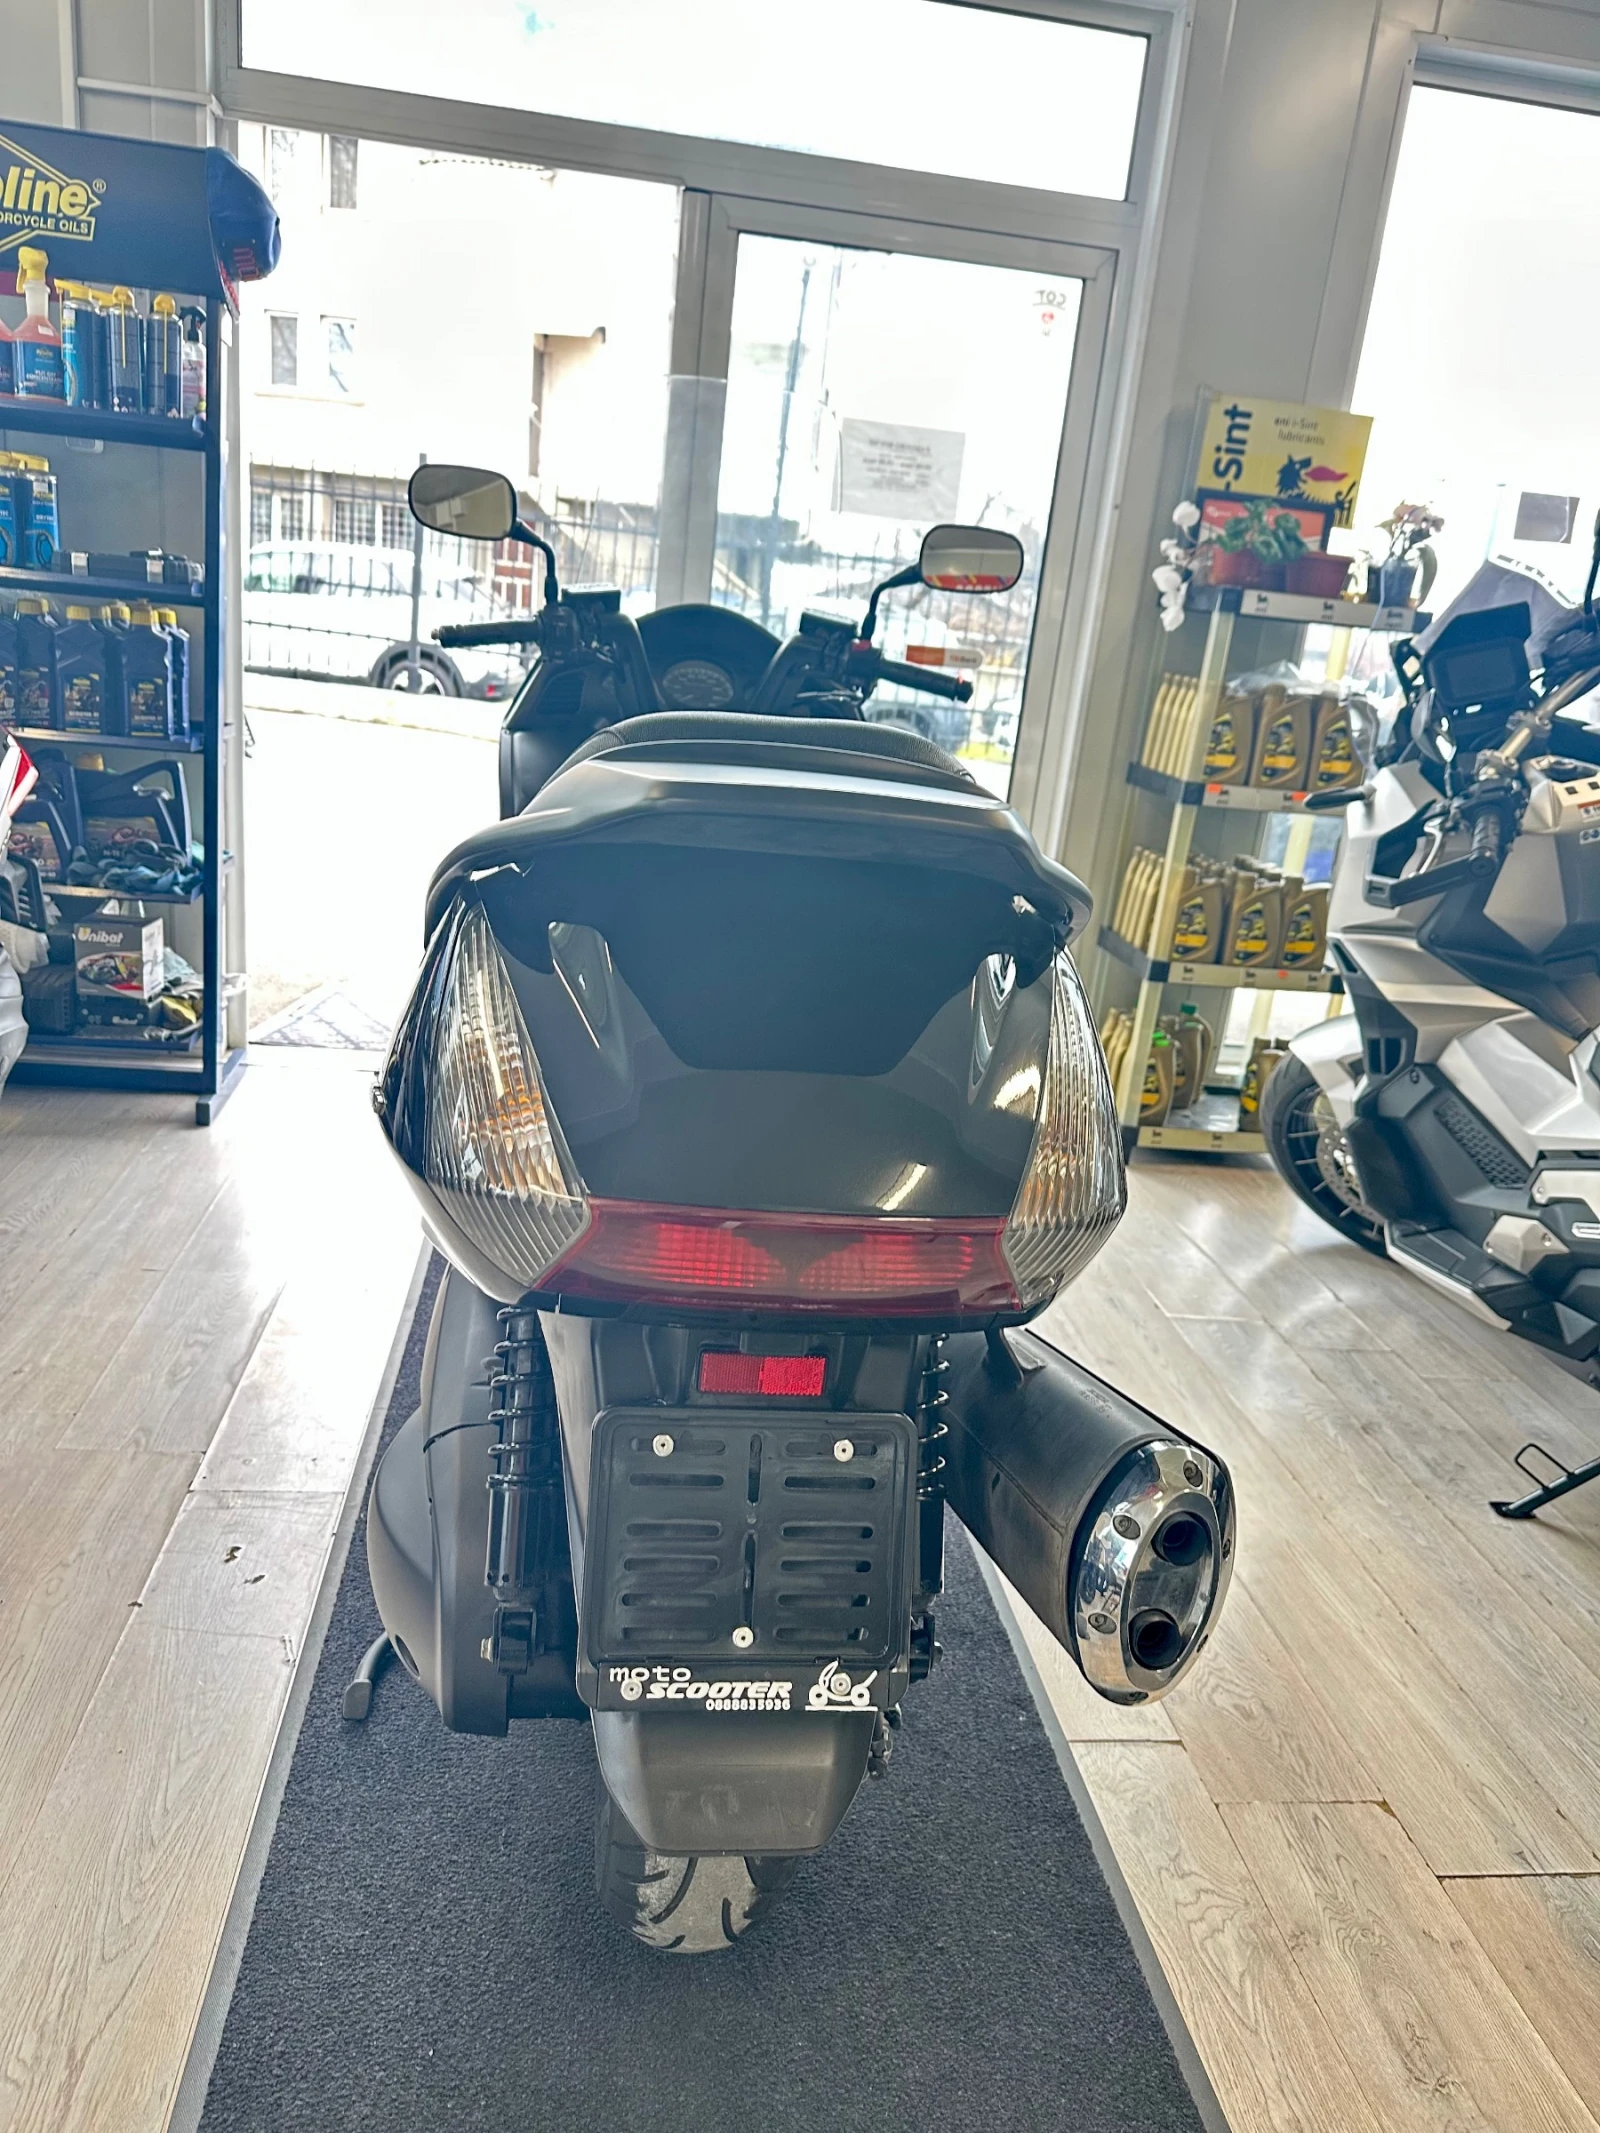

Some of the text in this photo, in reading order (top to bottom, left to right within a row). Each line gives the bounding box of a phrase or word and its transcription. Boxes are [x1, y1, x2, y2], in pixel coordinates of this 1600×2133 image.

[59, 219, 88, 234] OILS
[1277, 429, 1325, 446] lubricants
[77, 926, 124, 943] Unibat
[609, 1665, 692, 1682] moto
[645, 1681, 793, 1699] SCOOTER
